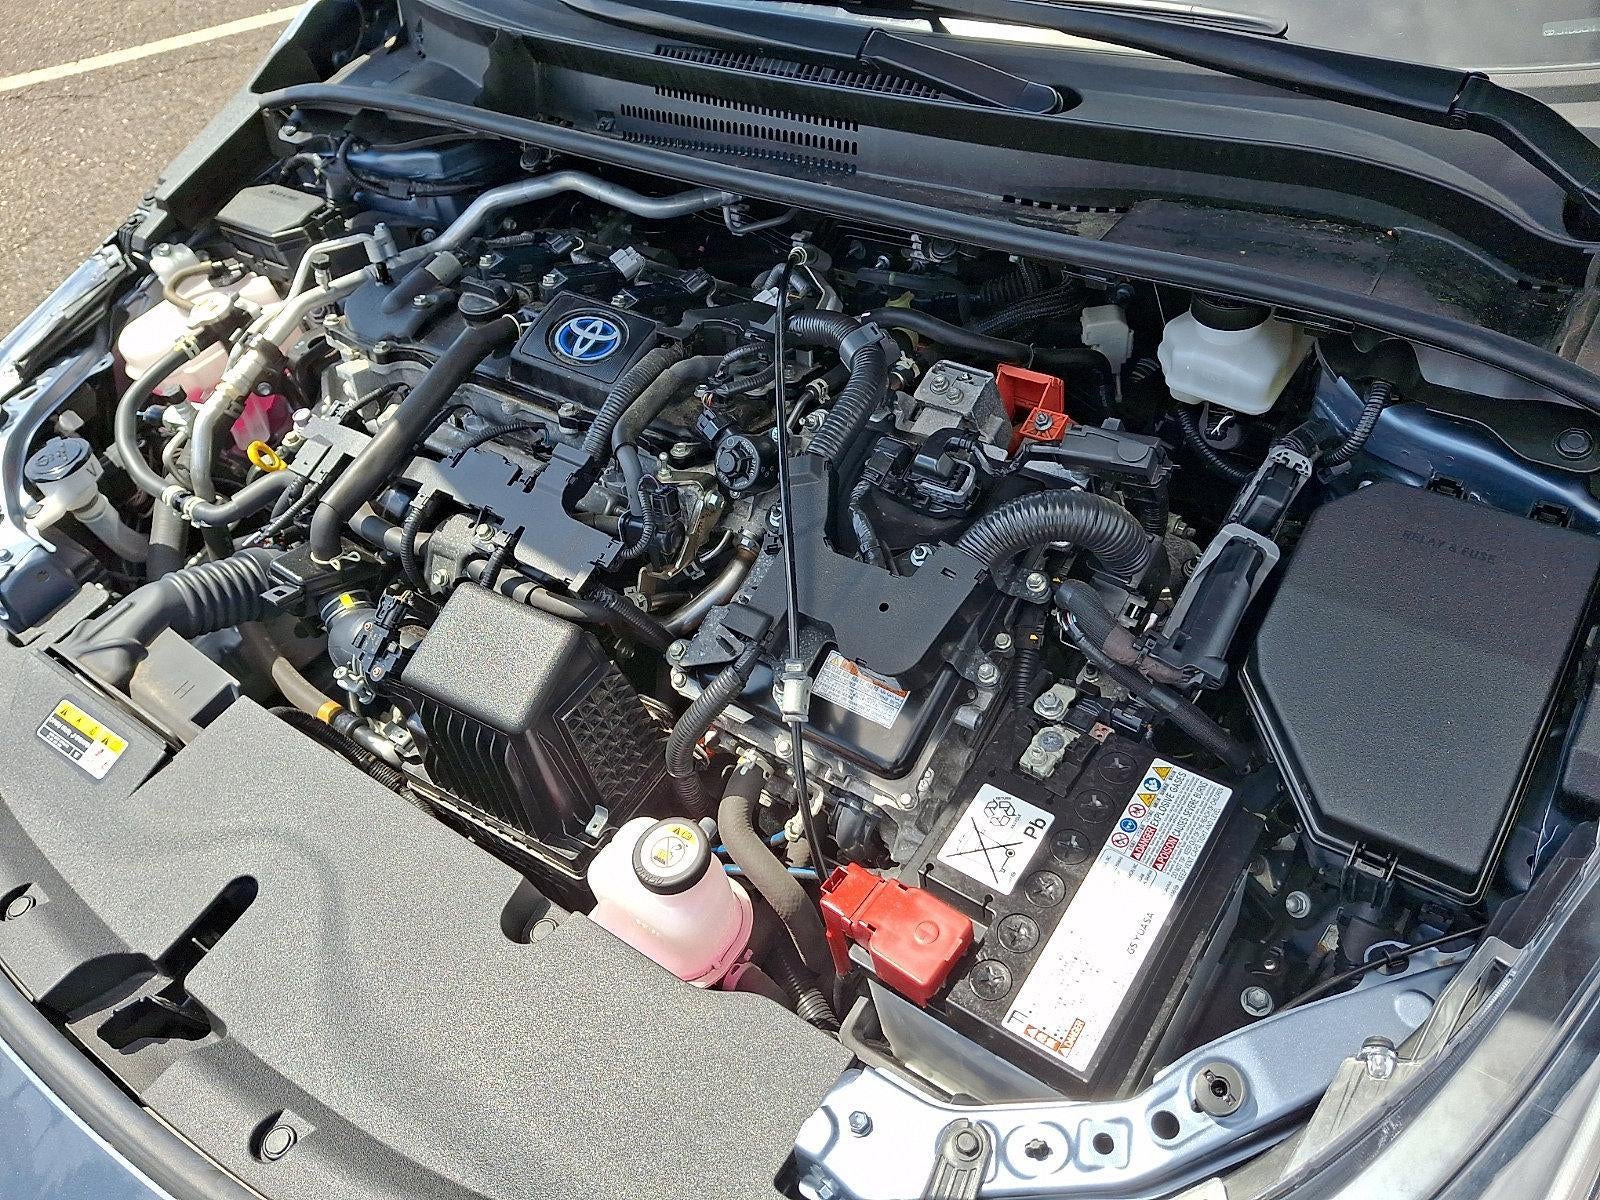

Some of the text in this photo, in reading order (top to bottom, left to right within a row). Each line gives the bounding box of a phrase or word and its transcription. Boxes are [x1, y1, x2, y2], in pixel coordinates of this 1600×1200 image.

[1461, 547, 1497, 565] FUSE
[1024, 818, 1046, 839] Pb
[1136, 828, 1155, 854] DANGER
[1150, 793, 1174, 826] EXPLOSIVE
[1170, 772, 1187, 792] GASES
[1159, 837, 1178, 866] POISON
[1172, 817, 1188, 836] CAUSES
[1183, 798, 1197, 816] SEVERE
[1193, 781, 1208, 798] BURNS
[1178, 869, 1187, 882] KEEP
[1184, 856, 1194, 869] VENT
[1205, 820, 1213, 830] AND
[1210, 808, 1221, 820] LEVEL
[1133, 912, 1155, 941] YUASA
